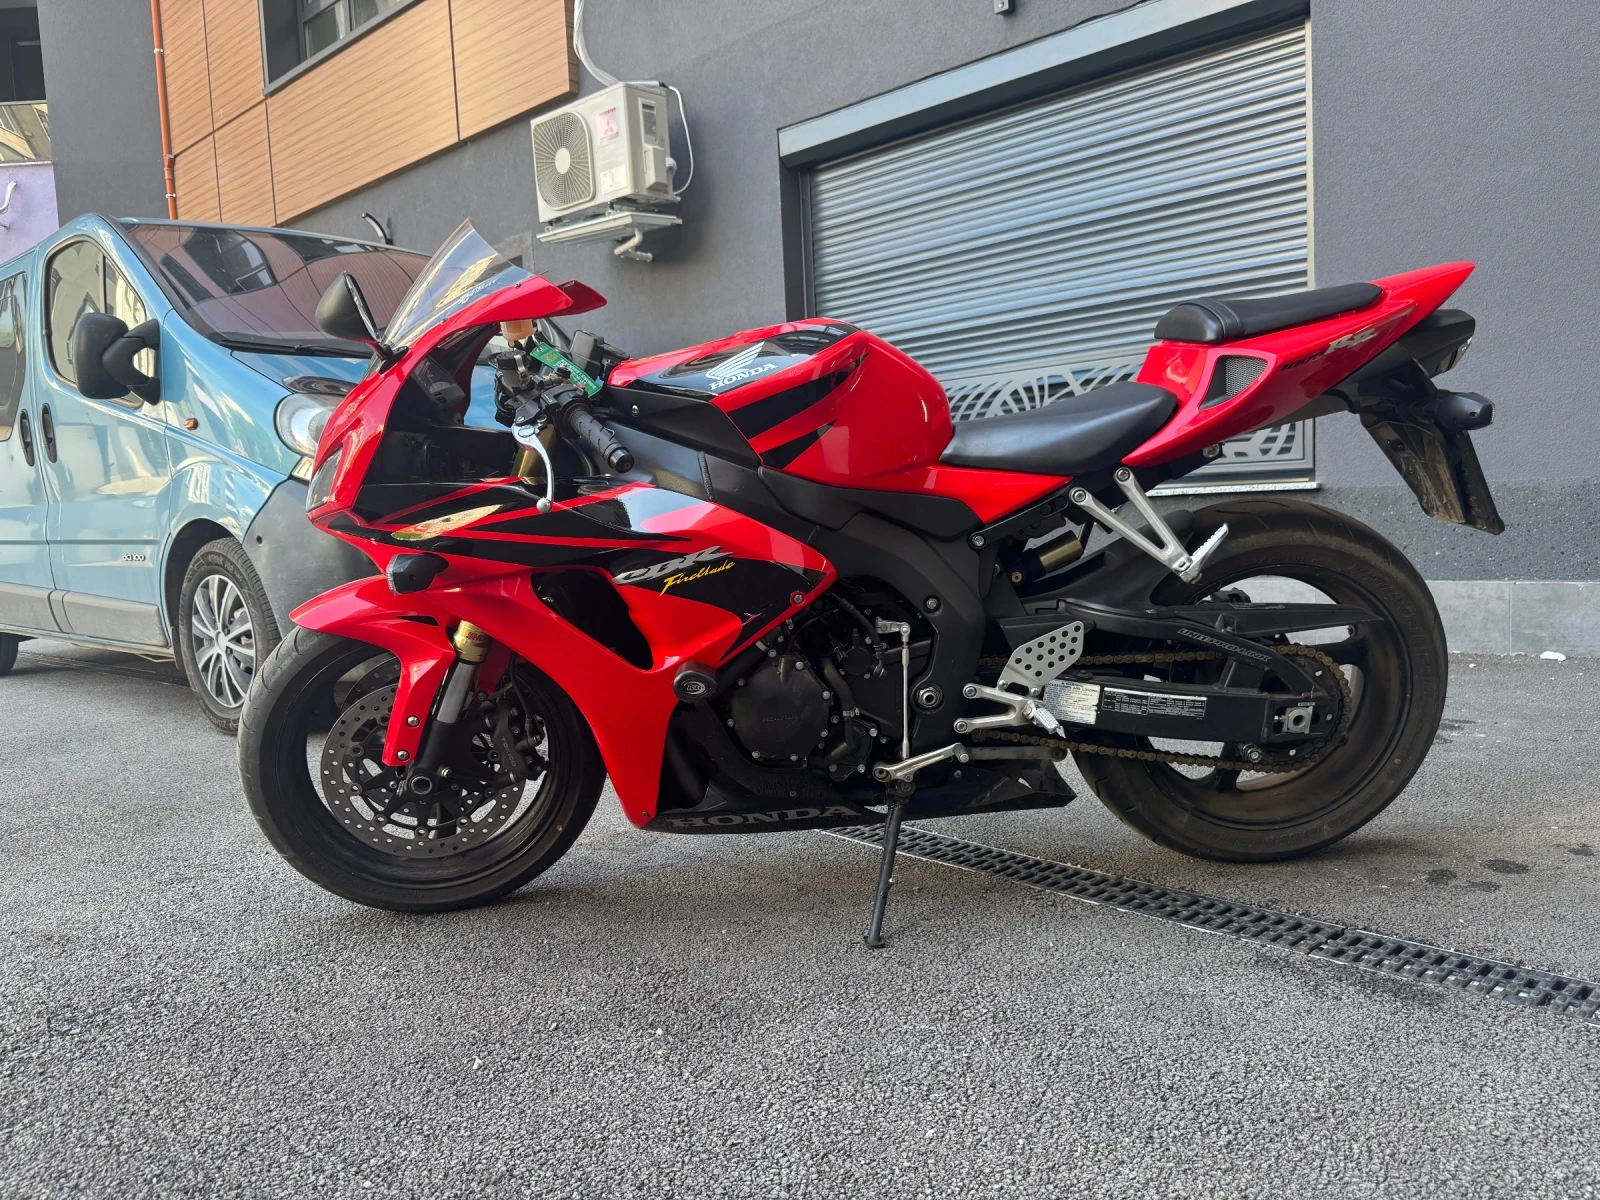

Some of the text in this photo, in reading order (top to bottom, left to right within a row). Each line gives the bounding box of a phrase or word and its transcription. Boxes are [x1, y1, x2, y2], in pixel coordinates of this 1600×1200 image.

[709, 363, 778, 391] HONDA
[612, 546, 735, 585] CBR
[659, 559, 736, 598] Fireblade
[501, 736, 517, 767] TOKICO
[666, 805, 862, 828] HONDA
